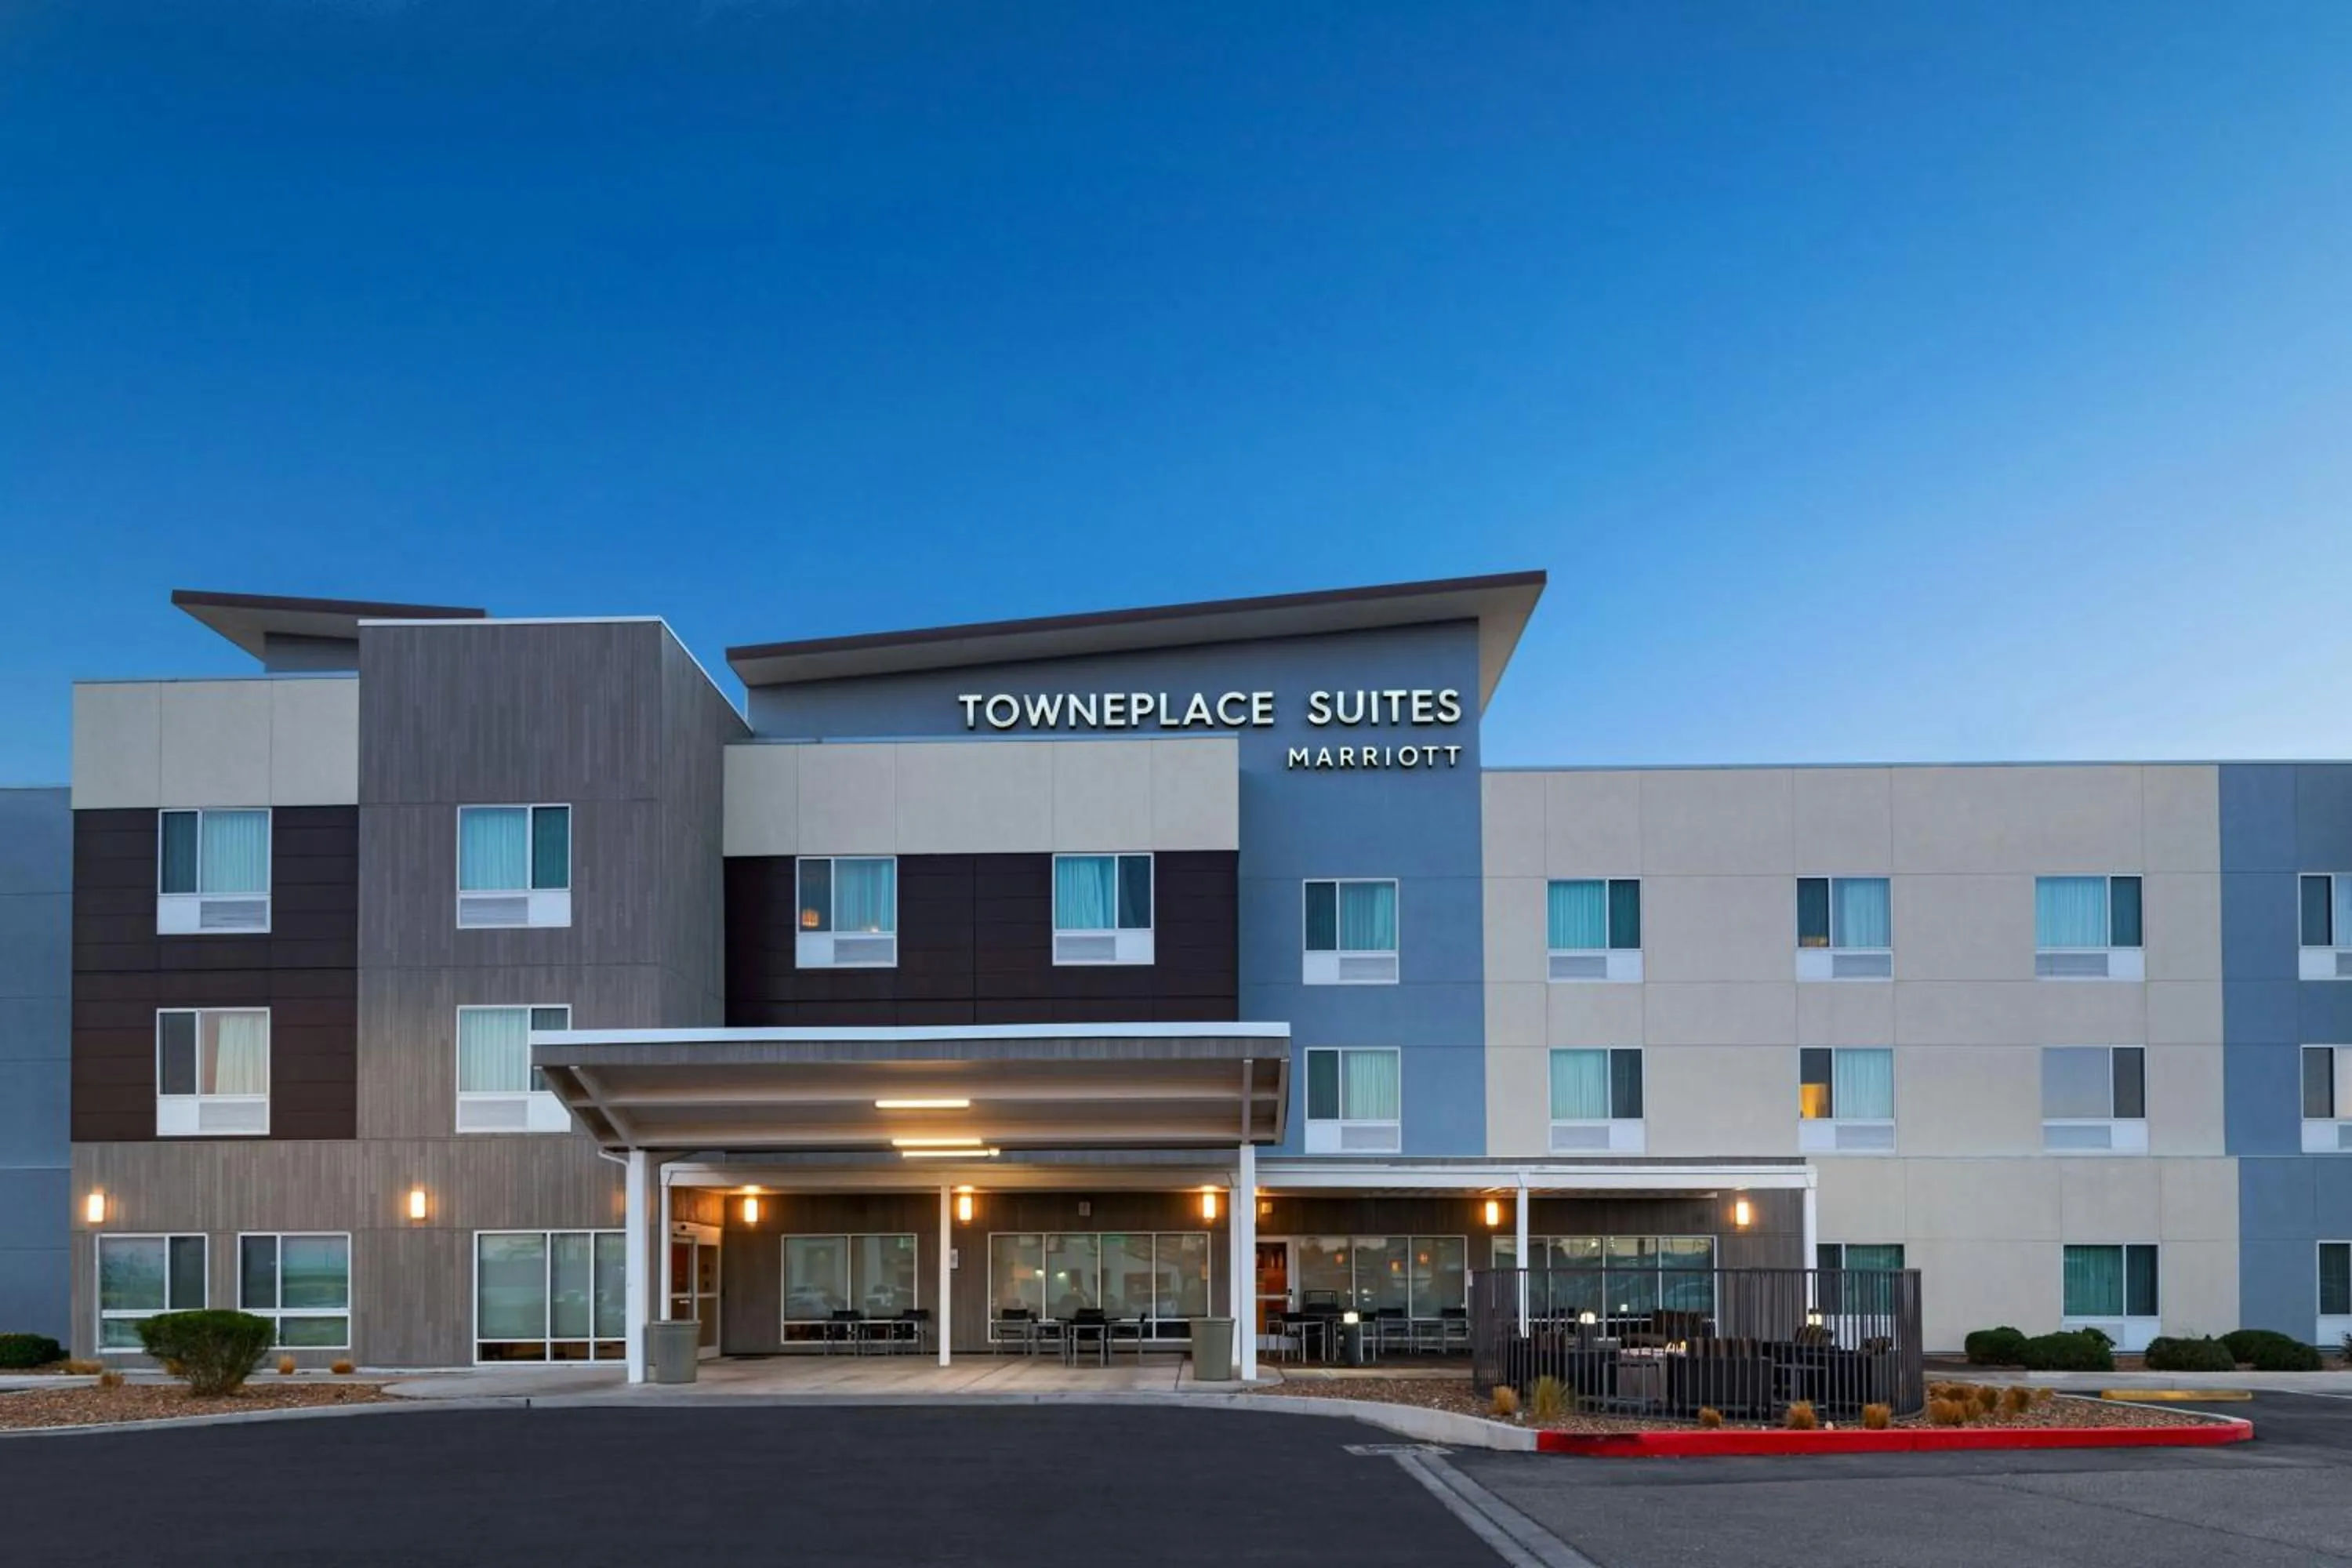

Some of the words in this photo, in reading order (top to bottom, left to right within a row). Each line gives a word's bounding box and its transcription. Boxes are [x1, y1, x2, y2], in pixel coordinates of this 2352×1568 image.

[958, 691, 1274, 728] TOWNEPLACE
[1307, 688, 1461, 725] SUITES
[1287, 745, 1461, 768] MARRIOTT
